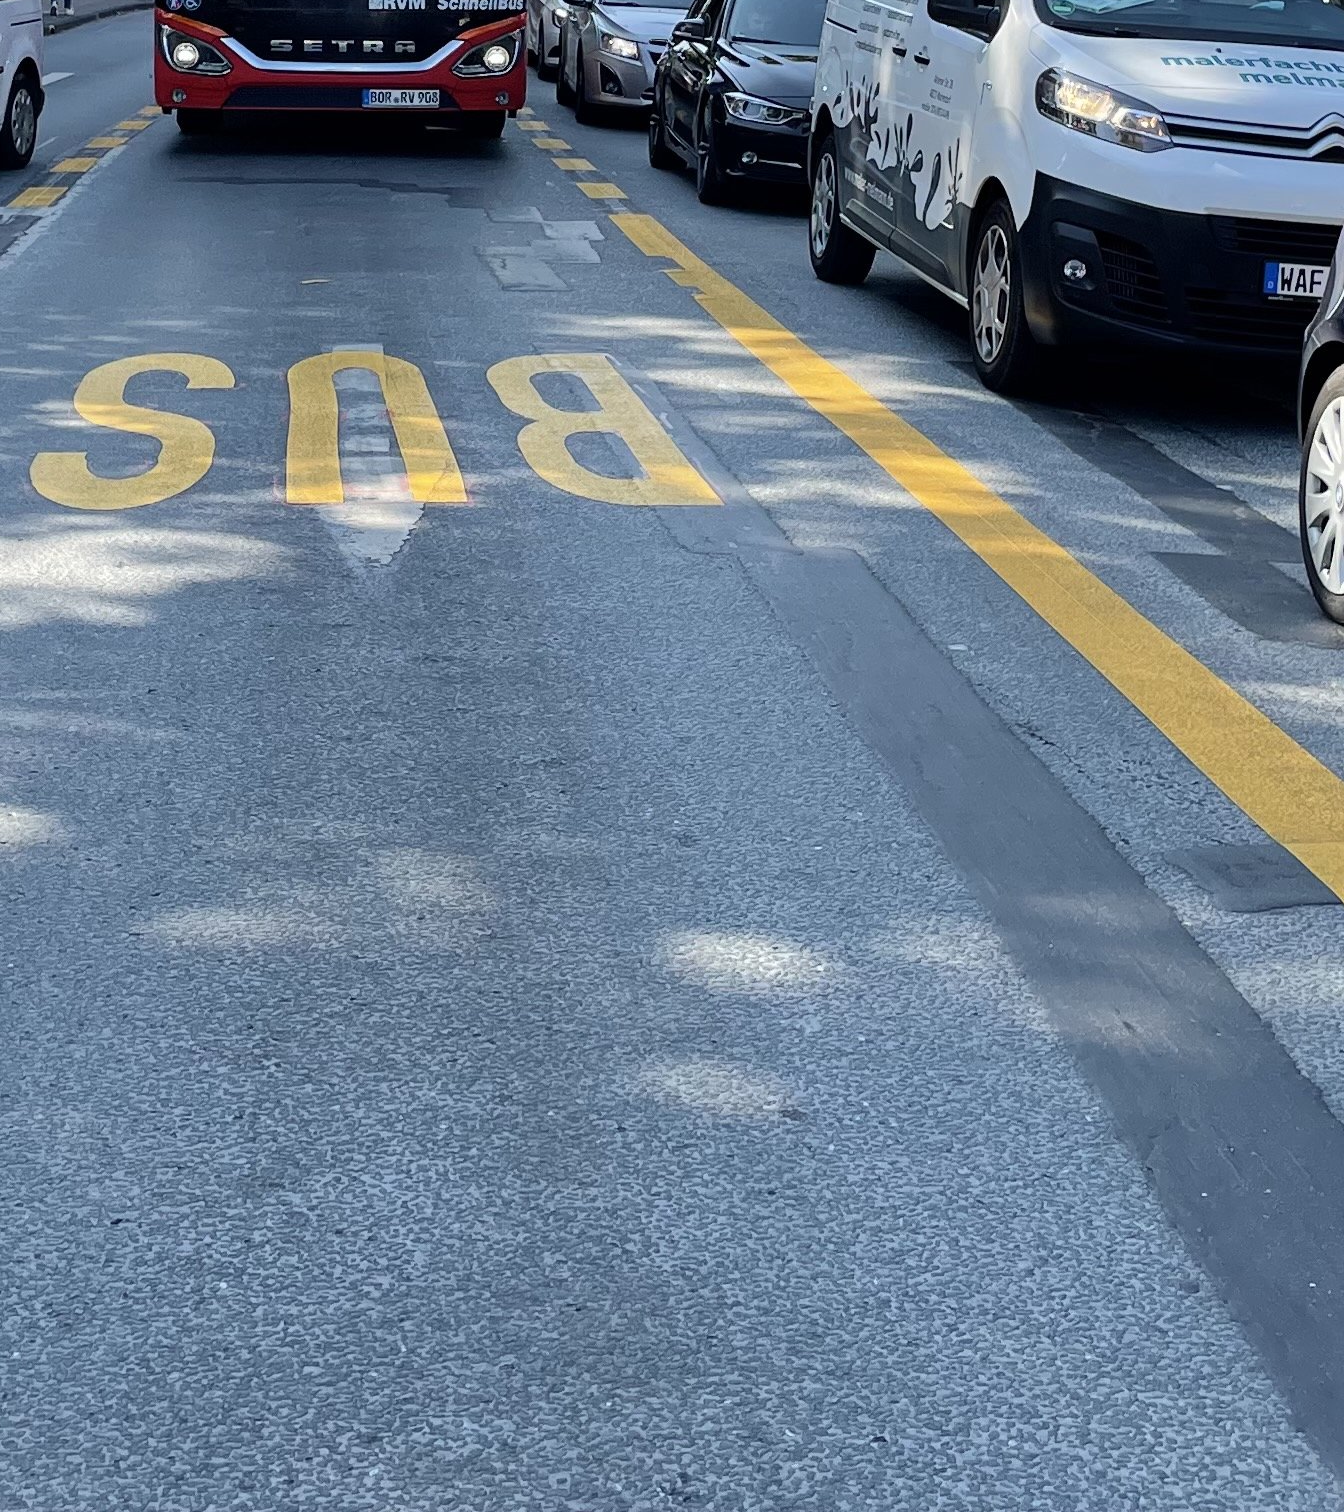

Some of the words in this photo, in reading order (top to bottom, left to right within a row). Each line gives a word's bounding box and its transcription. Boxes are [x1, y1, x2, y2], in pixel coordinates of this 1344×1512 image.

[270, 39, 416, 53] SETRA
[370, 91, 392, 103] BOR
[400, 91, 415, 104] RV
[418, 91, 439, 104] 908
[1280, 266, 1324, 294] WAF
[28, 352, 726, 511] BUS
